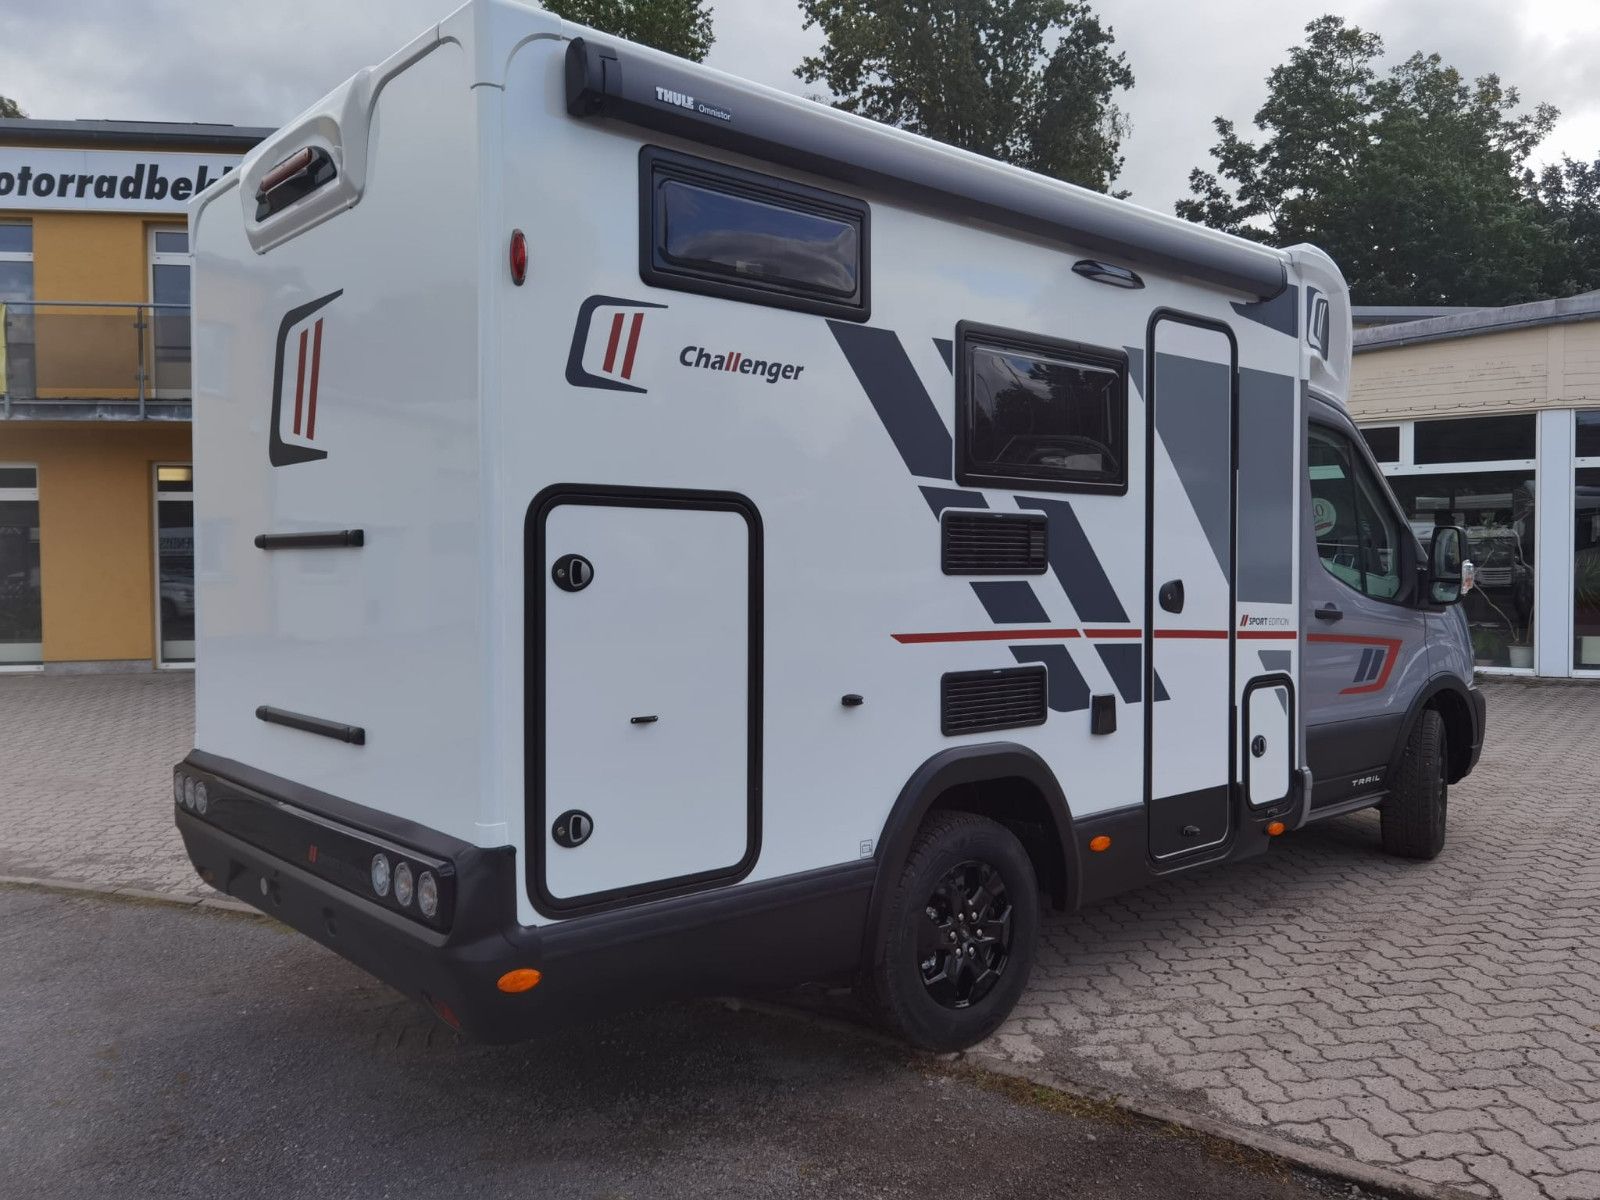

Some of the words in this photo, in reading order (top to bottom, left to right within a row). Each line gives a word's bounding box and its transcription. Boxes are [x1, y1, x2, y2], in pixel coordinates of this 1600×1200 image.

[655, 86, 694, 110] THULE
[698, 104, 731, 120] Omnistor
[0, 164, 233, 201] otorradbek
[679, 345, 804, 384] Challenger
[1249, 617, 1268, 626] SPORT
[1268, 617, 1290, 626] EDITION
[1352, 775, 1380, 786] TRAIL
